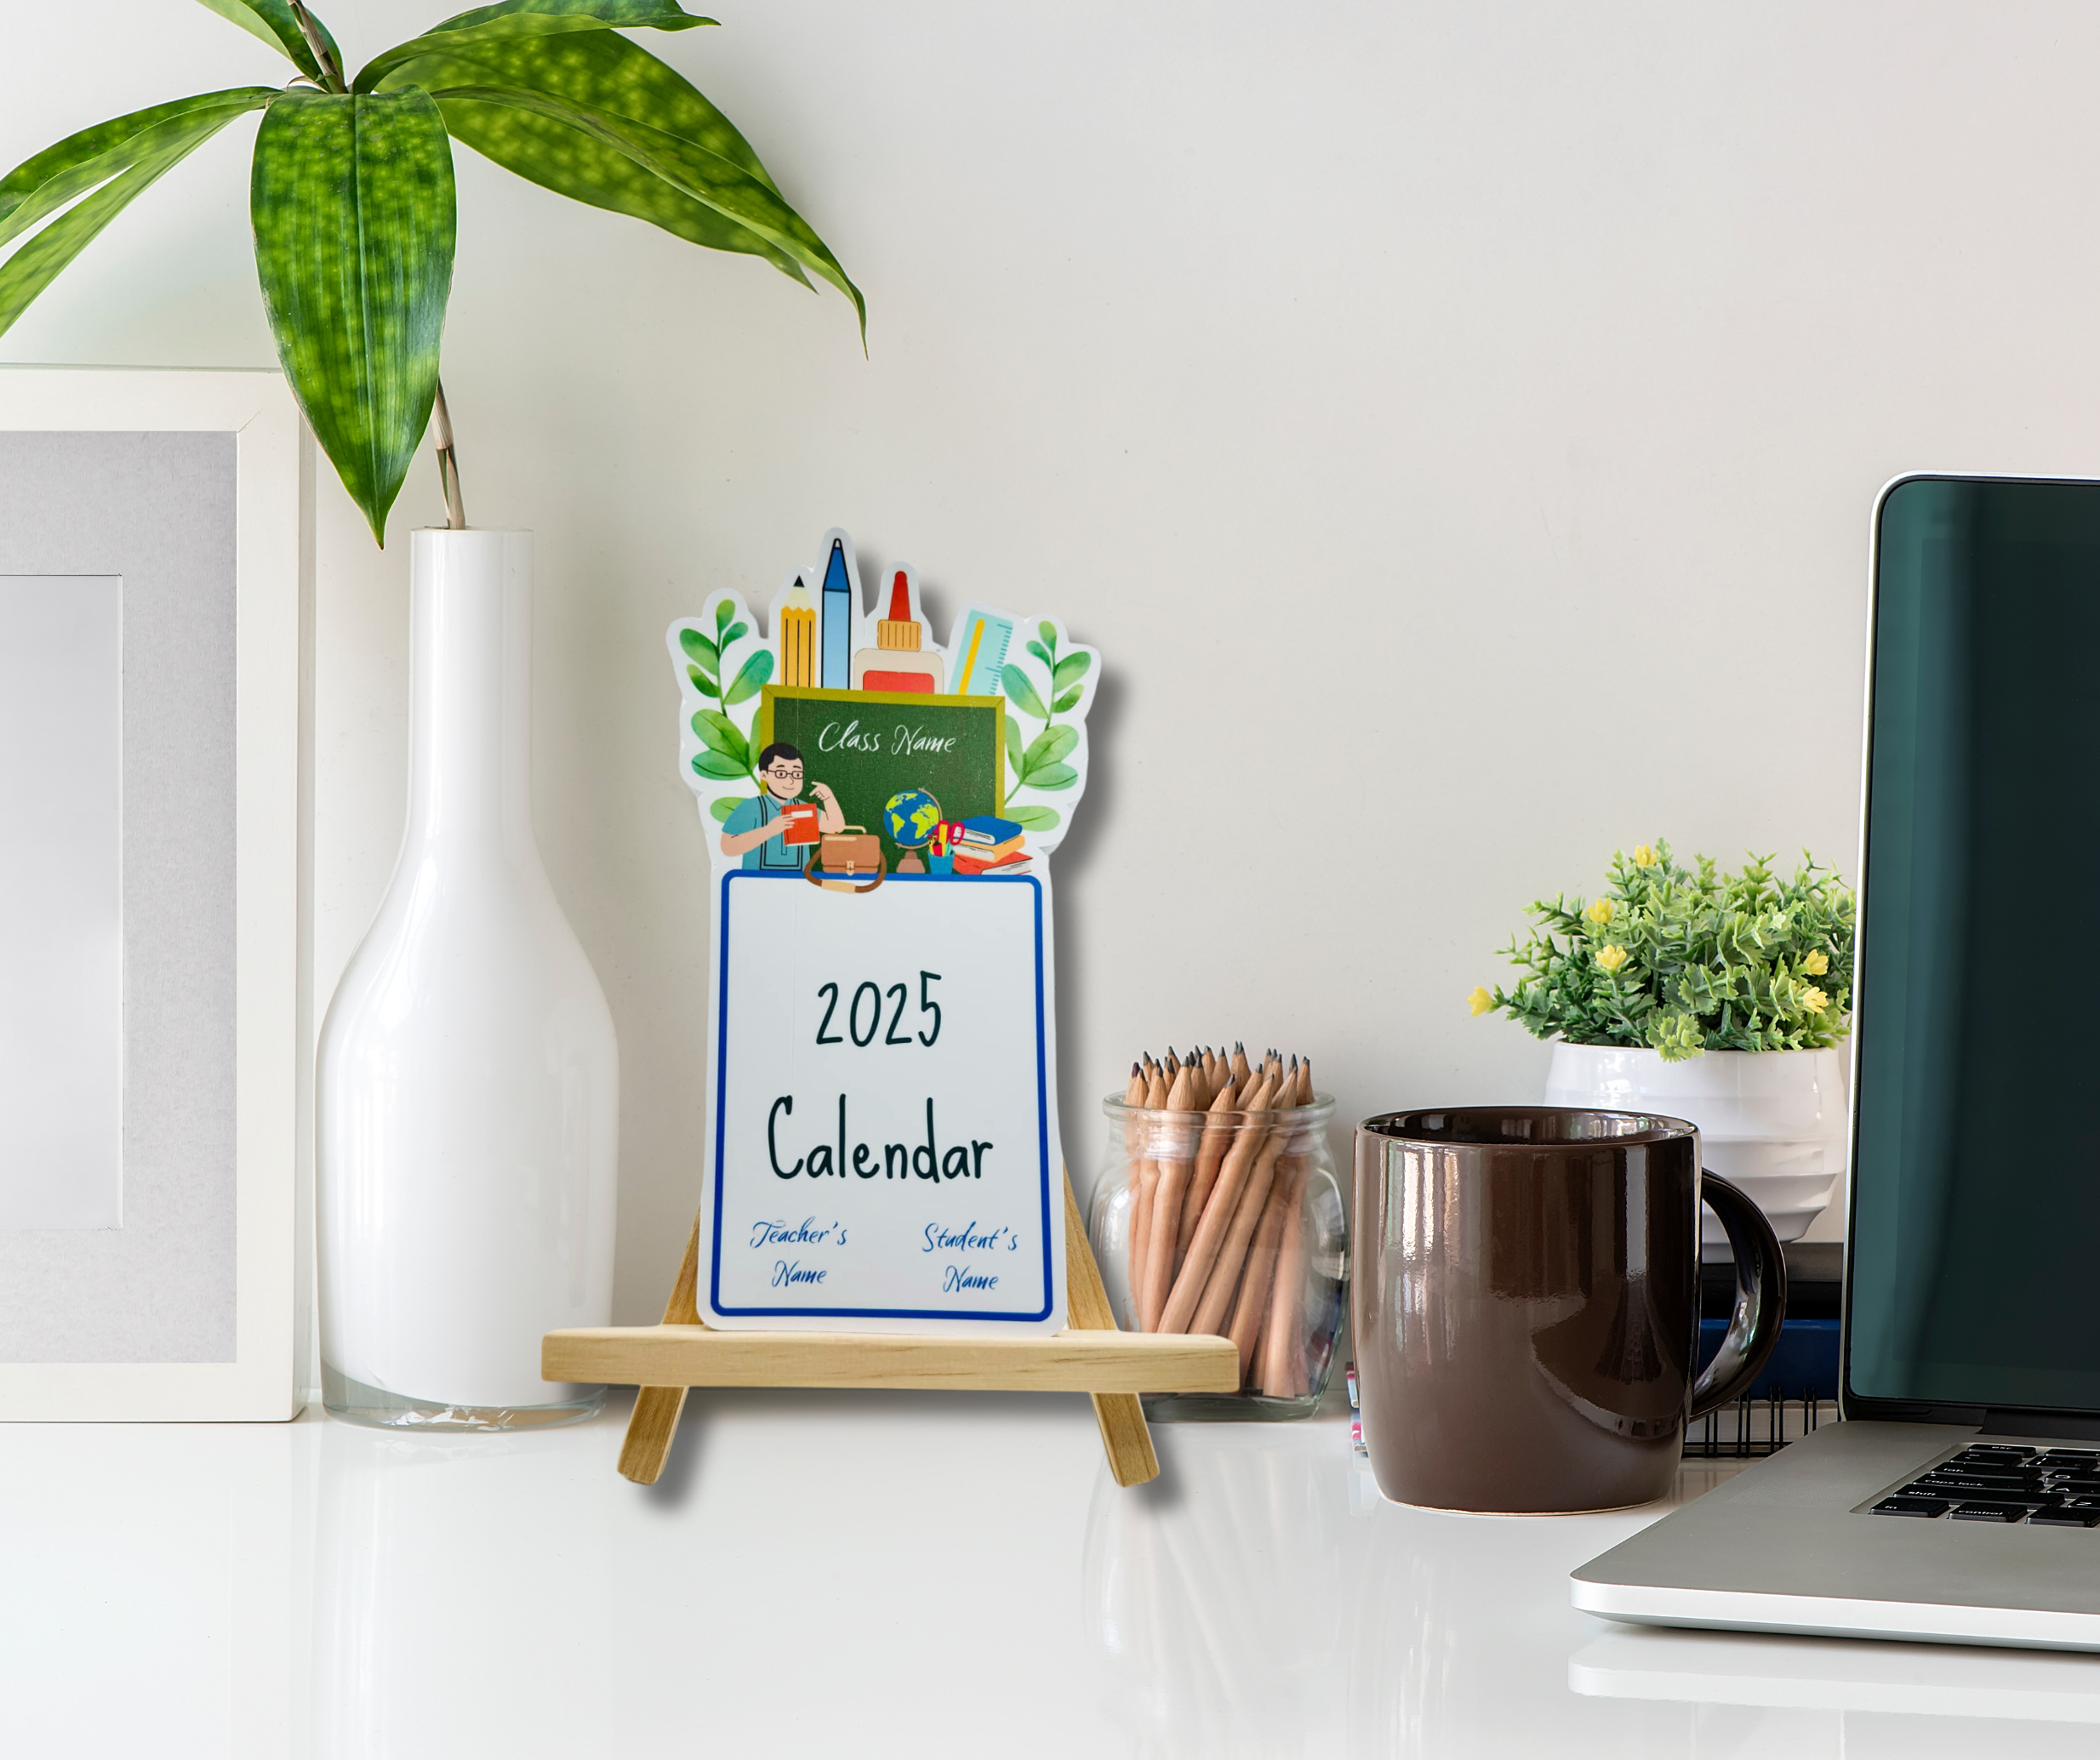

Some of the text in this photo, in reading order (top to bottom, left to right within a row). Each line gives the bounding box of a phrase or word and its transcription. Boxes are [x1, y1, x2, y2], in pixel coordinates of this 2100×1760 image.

[818, 721, 957, 755] Class Name
[816, 971, 942, 1047] 2025
[768, 1094, 993, 1183] Calendar
[750, 1216, 847, 1249] Teacher's
[922, 1221, 1019, 1253] Student's
[771, 1260, 828, 1288] Name
[942, 1266, 999, 1293] Name
